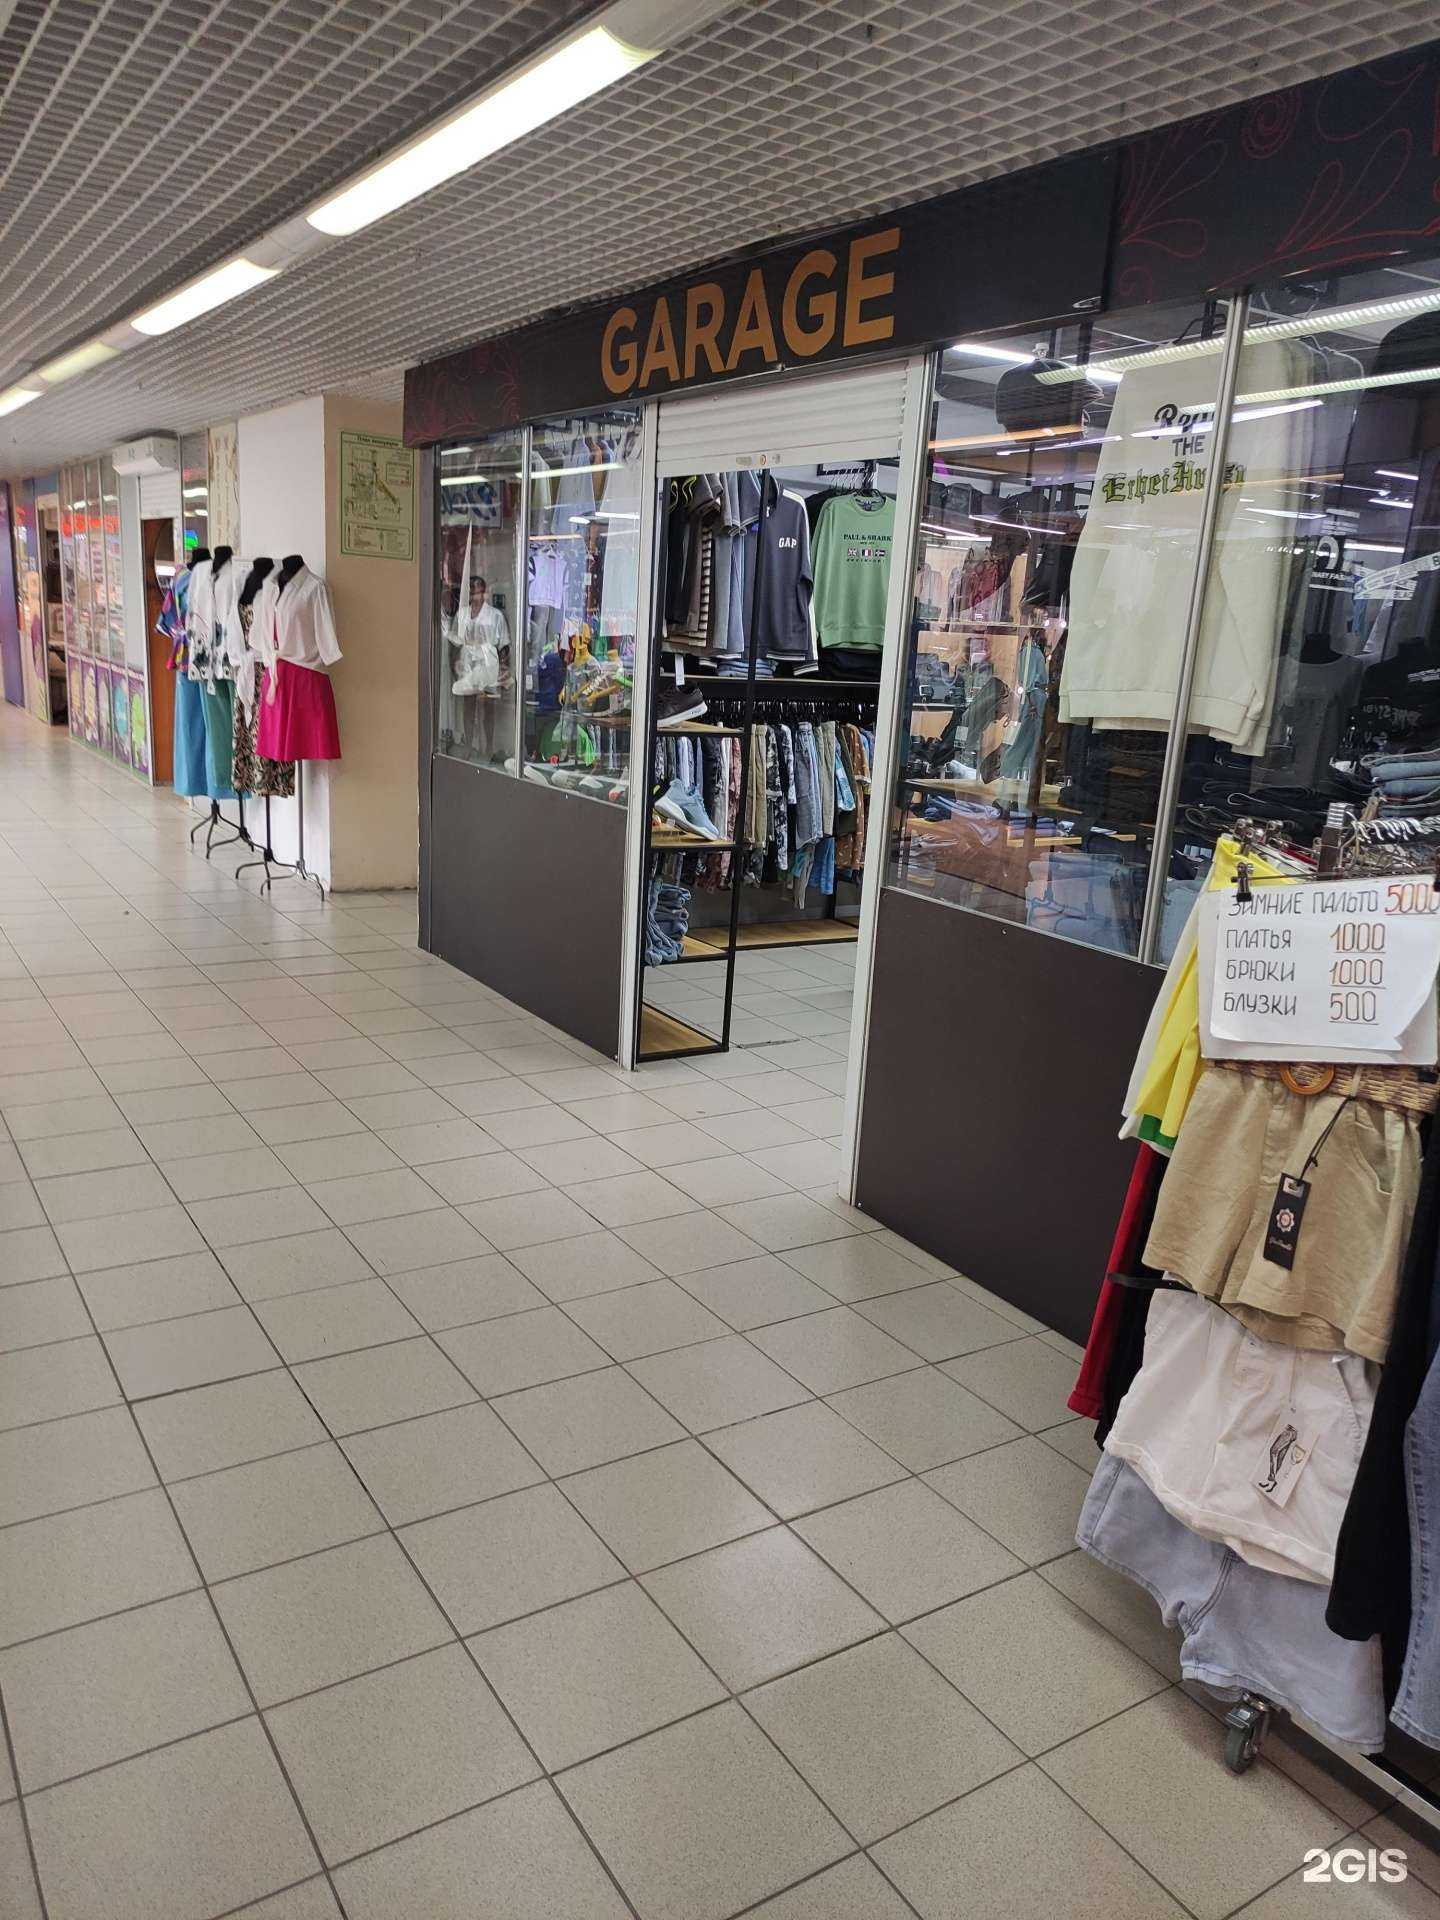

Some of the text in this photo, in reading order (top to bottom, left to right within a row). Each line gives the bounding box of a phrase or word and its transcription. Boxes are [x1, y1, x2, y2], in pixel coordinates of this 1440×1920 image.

[600, 227, 901, 394] GARAGE
[1172, 435, 1205, 457] THE
[778, 536, 797, 549] GAP
[1227, 891, 1304, 917] ЗИМНИЕ
[1312, 889, 1378, 914] ПАЛЬТО
[1225, 922, 1386, 951] ПЛАТЬЯ 1000
[1225, 958, 1383, 986] БРЮКИ 1000
[1223, 991, 1376, 1023] БЛУЗКИ 500
